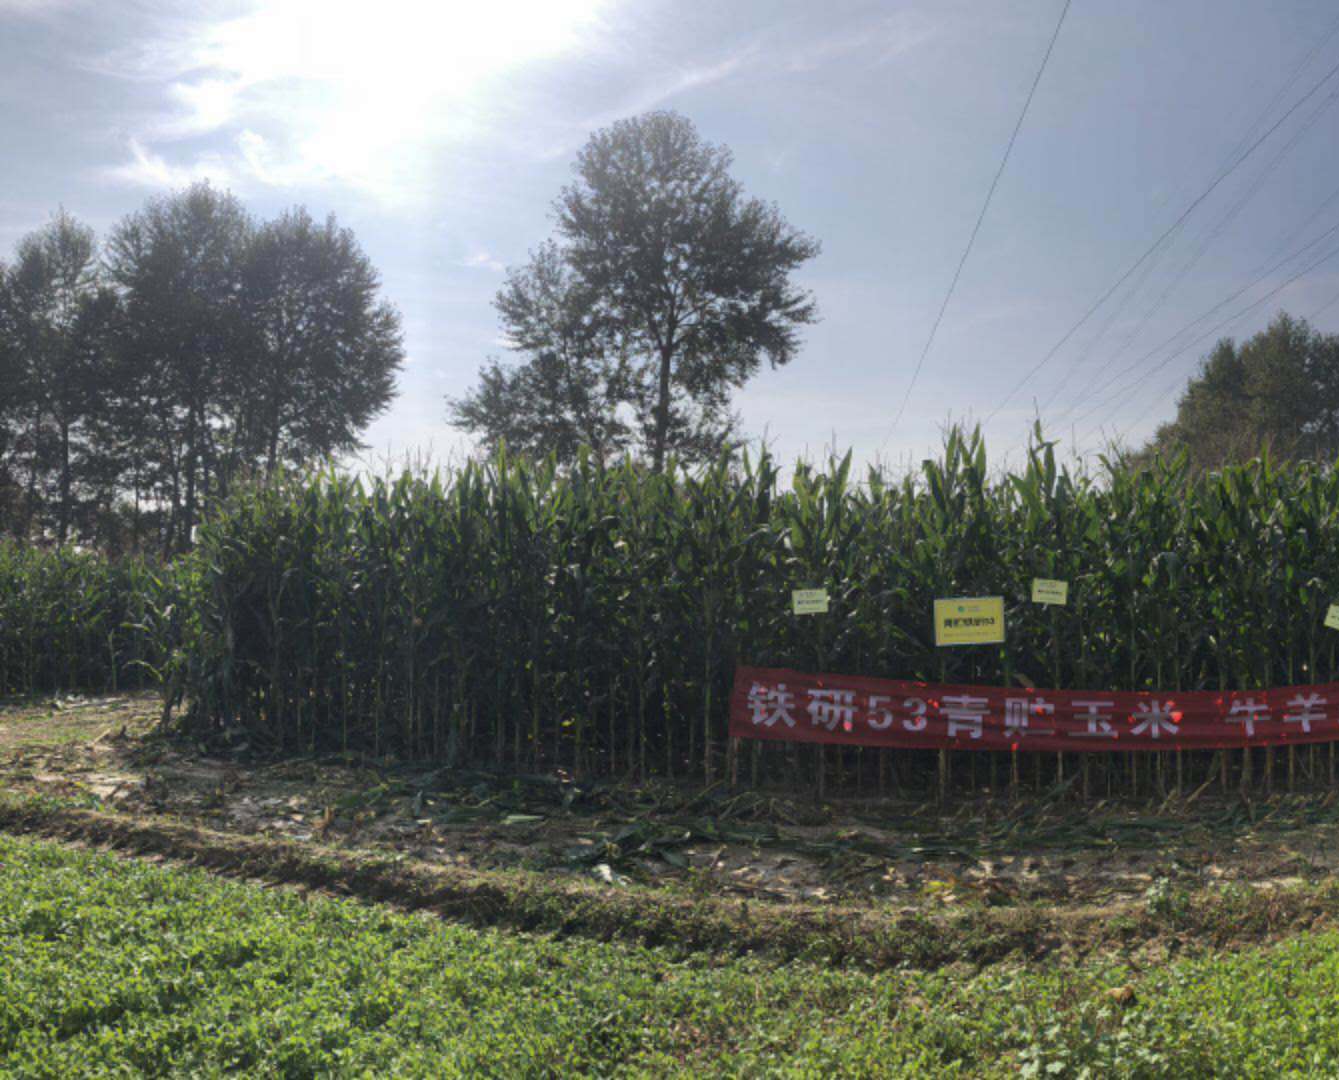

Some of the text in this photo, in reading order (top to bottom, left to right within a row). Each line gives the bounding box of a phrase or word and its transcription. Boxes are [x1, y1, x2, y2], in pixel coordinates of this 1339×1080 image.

[747, 682, 1180, 738] 铁研53青贮玉米
